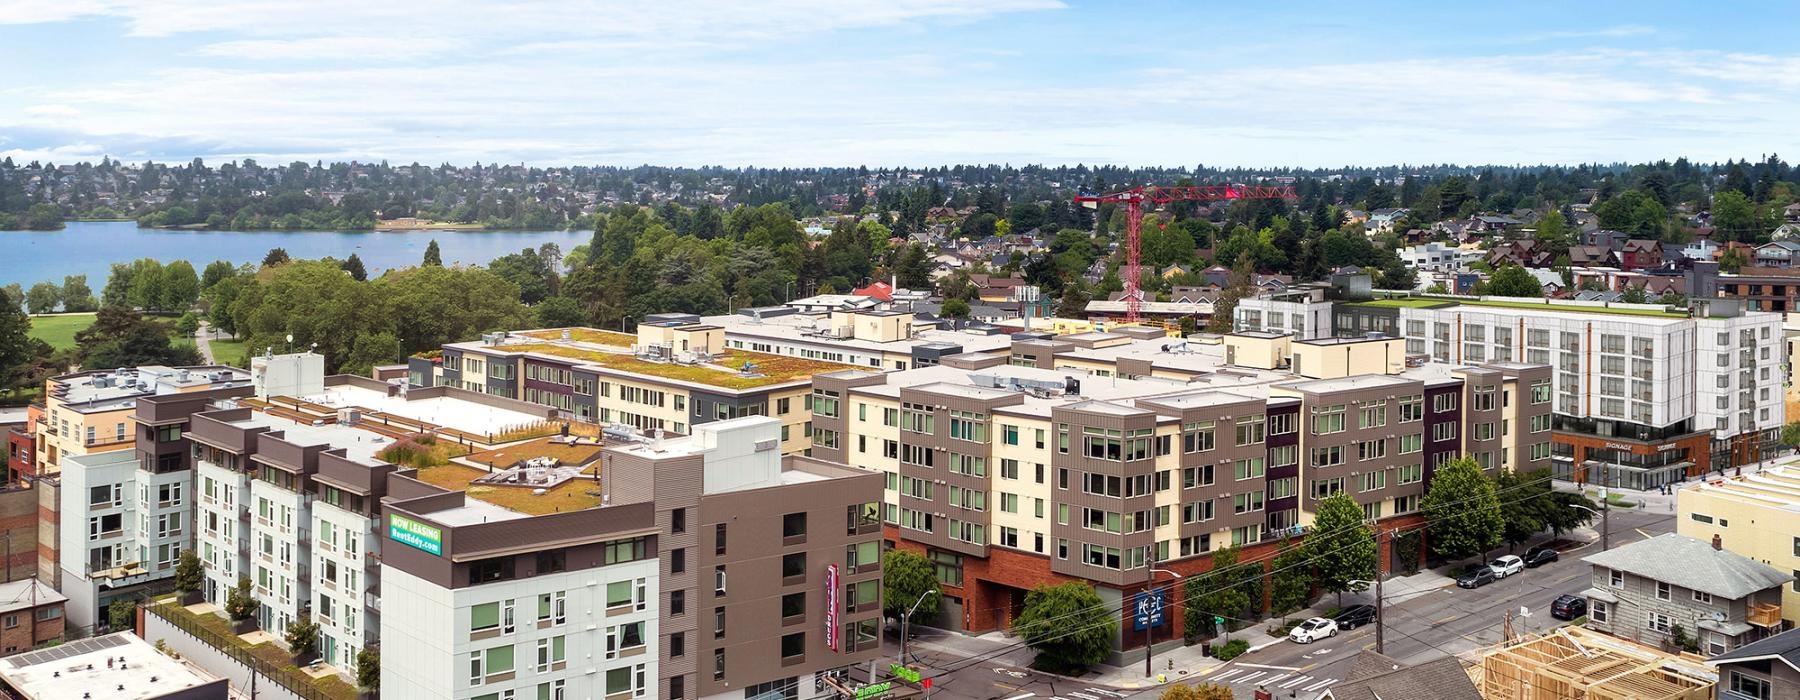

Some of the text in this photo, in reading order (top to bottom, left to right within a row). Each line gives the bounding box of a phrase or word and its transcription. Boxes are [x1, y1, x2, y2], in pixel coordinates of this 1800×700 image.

[1606, 442, 1632, 451] SIGNAGE
[392, 516, 439, 540] NOW LEASING
[392, 528, 439, 552] RentEddy.com
[857, 681, 891, 698] EDDY
